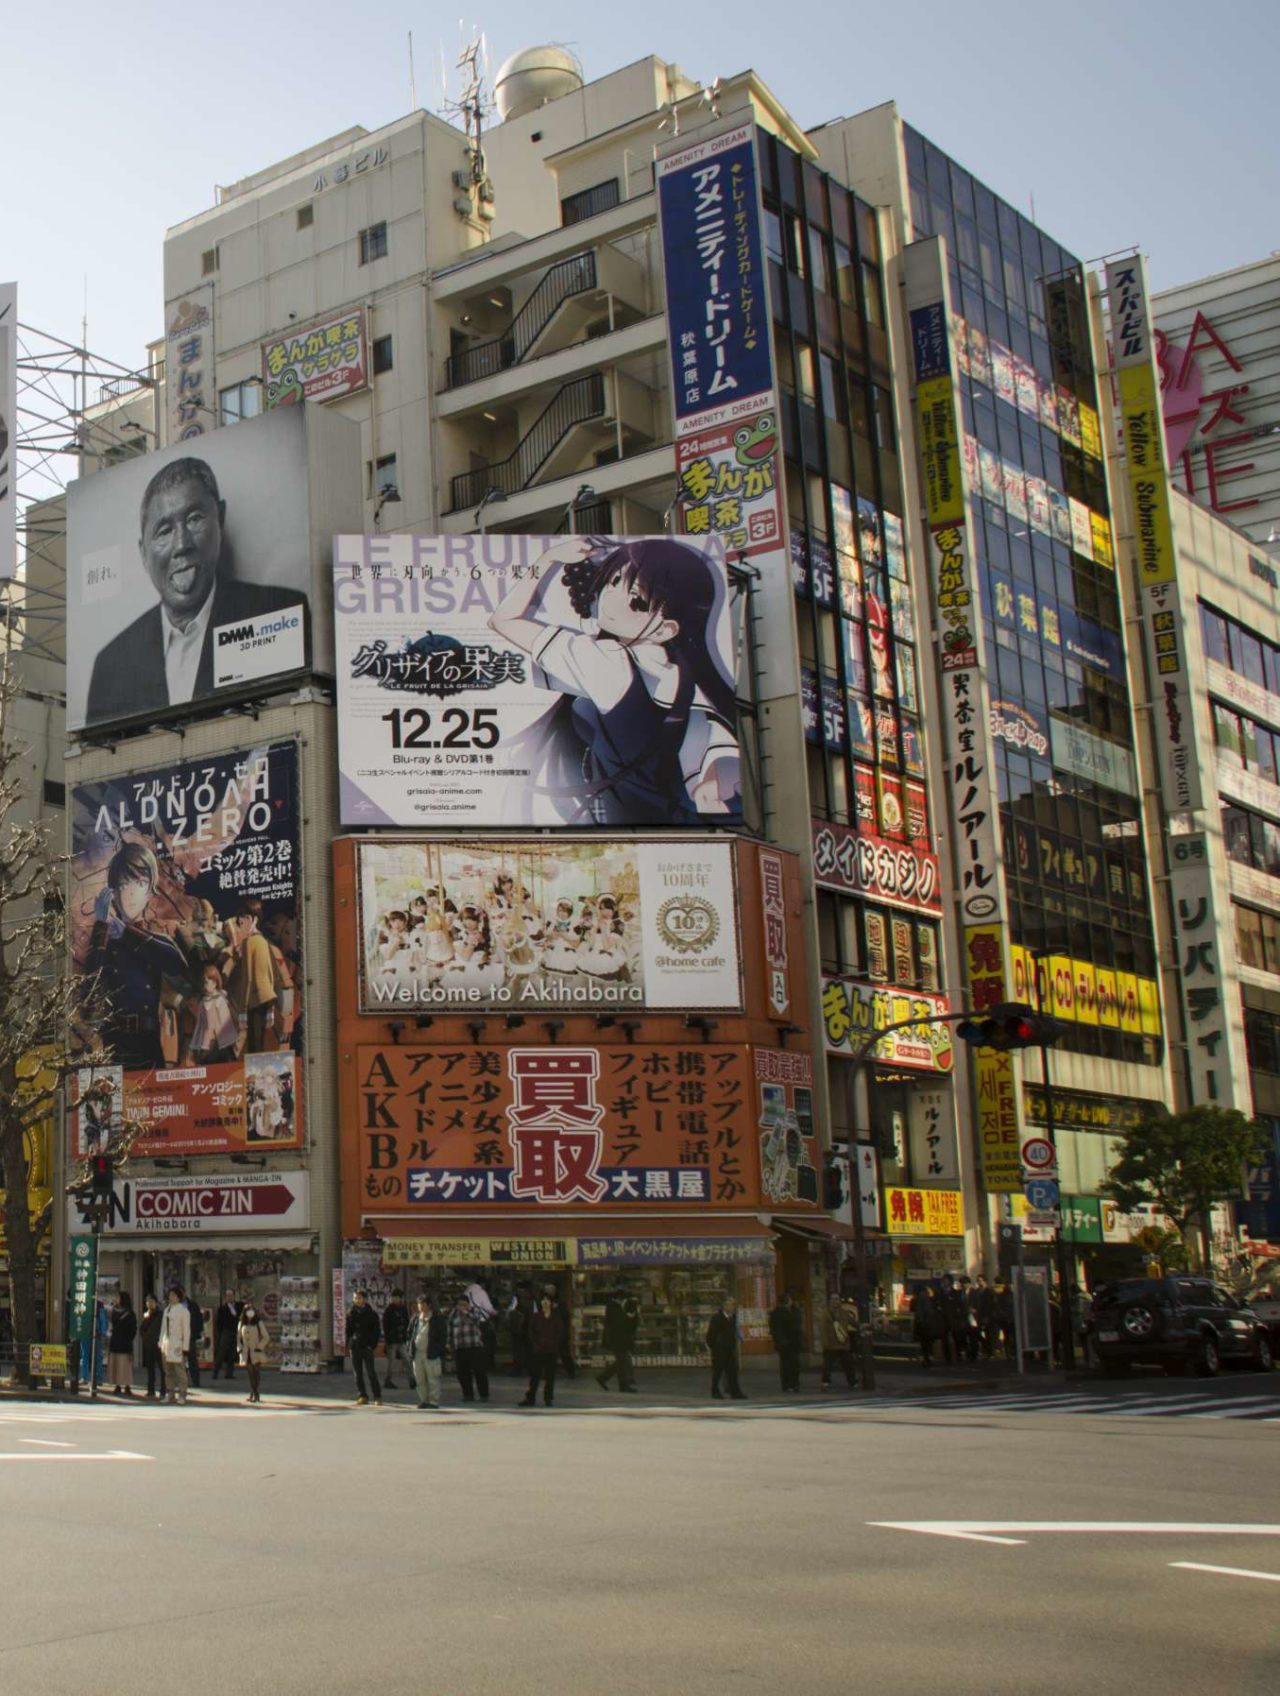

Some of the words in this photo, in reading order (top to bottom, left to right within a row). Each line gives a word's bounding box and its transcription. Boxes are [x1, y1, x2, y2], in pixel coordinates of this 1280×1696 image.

[663, 149, 705, 170] AMENITY
[711, 130, 747, 152] DREAM
[691, 163, 738, 397] アメニティードリーム
[680, 331, 701, 405] 秋葉原店
[682, 411, 725, 431] AMENITY
[732, 398, 768, 416] DREAM
[1128, 411, 1147, 467] Yellow
[683, 458, 776, 499] まんが
[686, 498, 742, 534] 喫茶
[934, 527, 964, 590] まんが
[1150, 586, 1170, 599] 5F
[252, 635, 277, 648] PRINT
[351, 639, 527, 687] グリザイアの果実
[382, 707, 500, 750] 12.25
[392, 754, 431, 766] Blu-ray
[434, 754, 443, 764] &
[406, 788, 483, 797] grisaia-anime.com
[199, 838, 293, 875] コミック第2巻
[815, 828, 935, 904] メイドカジノ
[662, 872, 711, 888] 10周年
[672, 913, 694, 931] 10
[372, 979, 483, 1006] Welcome
[488, 982, 511, 1003] to
[519, 977, 645, 1004] Akihabara
[774, 974, 785, 1004] 入口
[1177, 896, 1222, 1100] リバティー
[191, 1081, 243, 1096] アンソロジー
[211, 1094, 243, 1106] コミック
[404, 1051, 438, 1163] アイドル
[438, 1051, 470, 1133] アニメ
[641, 1051, 673, 1134] ホビー
[362, 1052, 402, 1198] AKBもの
[468, 1051, 505, 1166] 美少女系
[506, 1048, 609, 1204] 買取
[609, 1051, 643, 1167] フィギュア
[674, 1051, 711, 1166] 携帯電話
[712, 1051, 747, 1202] アップルとか
[997, 1080, 1019, 1144] FREE
[1029, 1146, 1048, 1161] 40
[409, 1169, 508, 1199] チケット
[612, 1169, 706, 1199] 大黒屋
[1032, 1186, 1046, 1207] P
[136, 1189, 215, 1218] COMIC
[220, 1188, 254, 1215] ZIN
[135, 1217, 202, 1231] Akihabara
[387, 1242, 425, 1252] MONEY
[429, 1242, 481, 1252] TRANSFER
[489, 1241, 554, 1252] WESTERN
[510, 1251, 554, 1261] UNION
[74, 1268, 89, 1315] 神田明神
